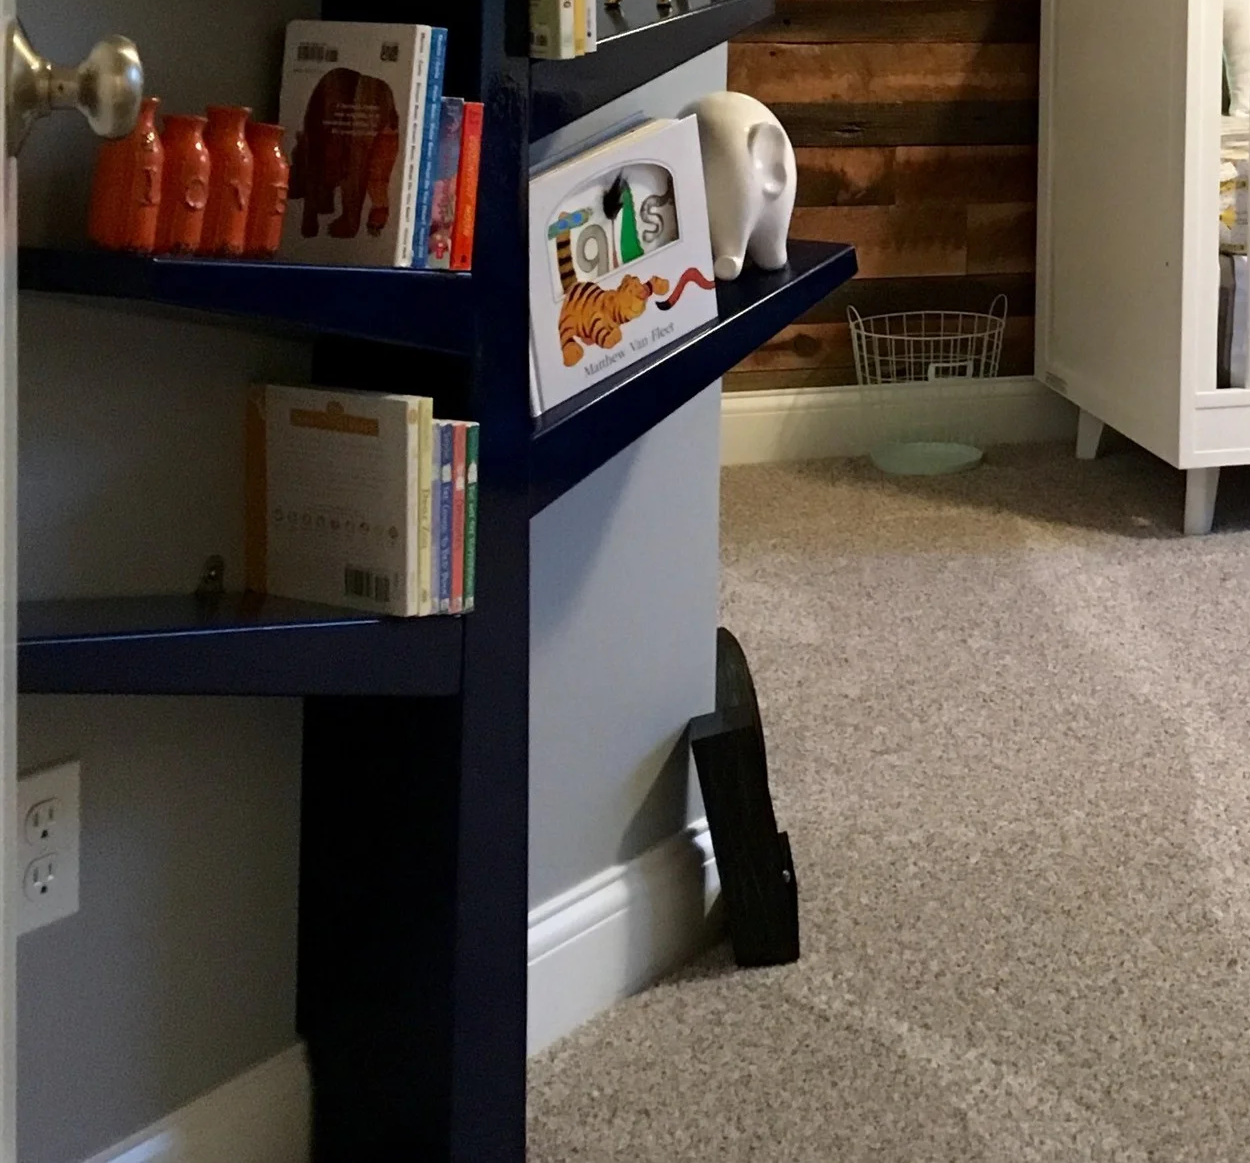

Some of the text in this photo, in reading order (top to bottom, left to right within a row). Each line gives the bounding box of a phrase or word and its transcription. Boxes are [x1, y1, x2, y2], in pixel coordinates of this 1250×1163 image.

[584, 321, 675, 379] Matthew Van Fleet
